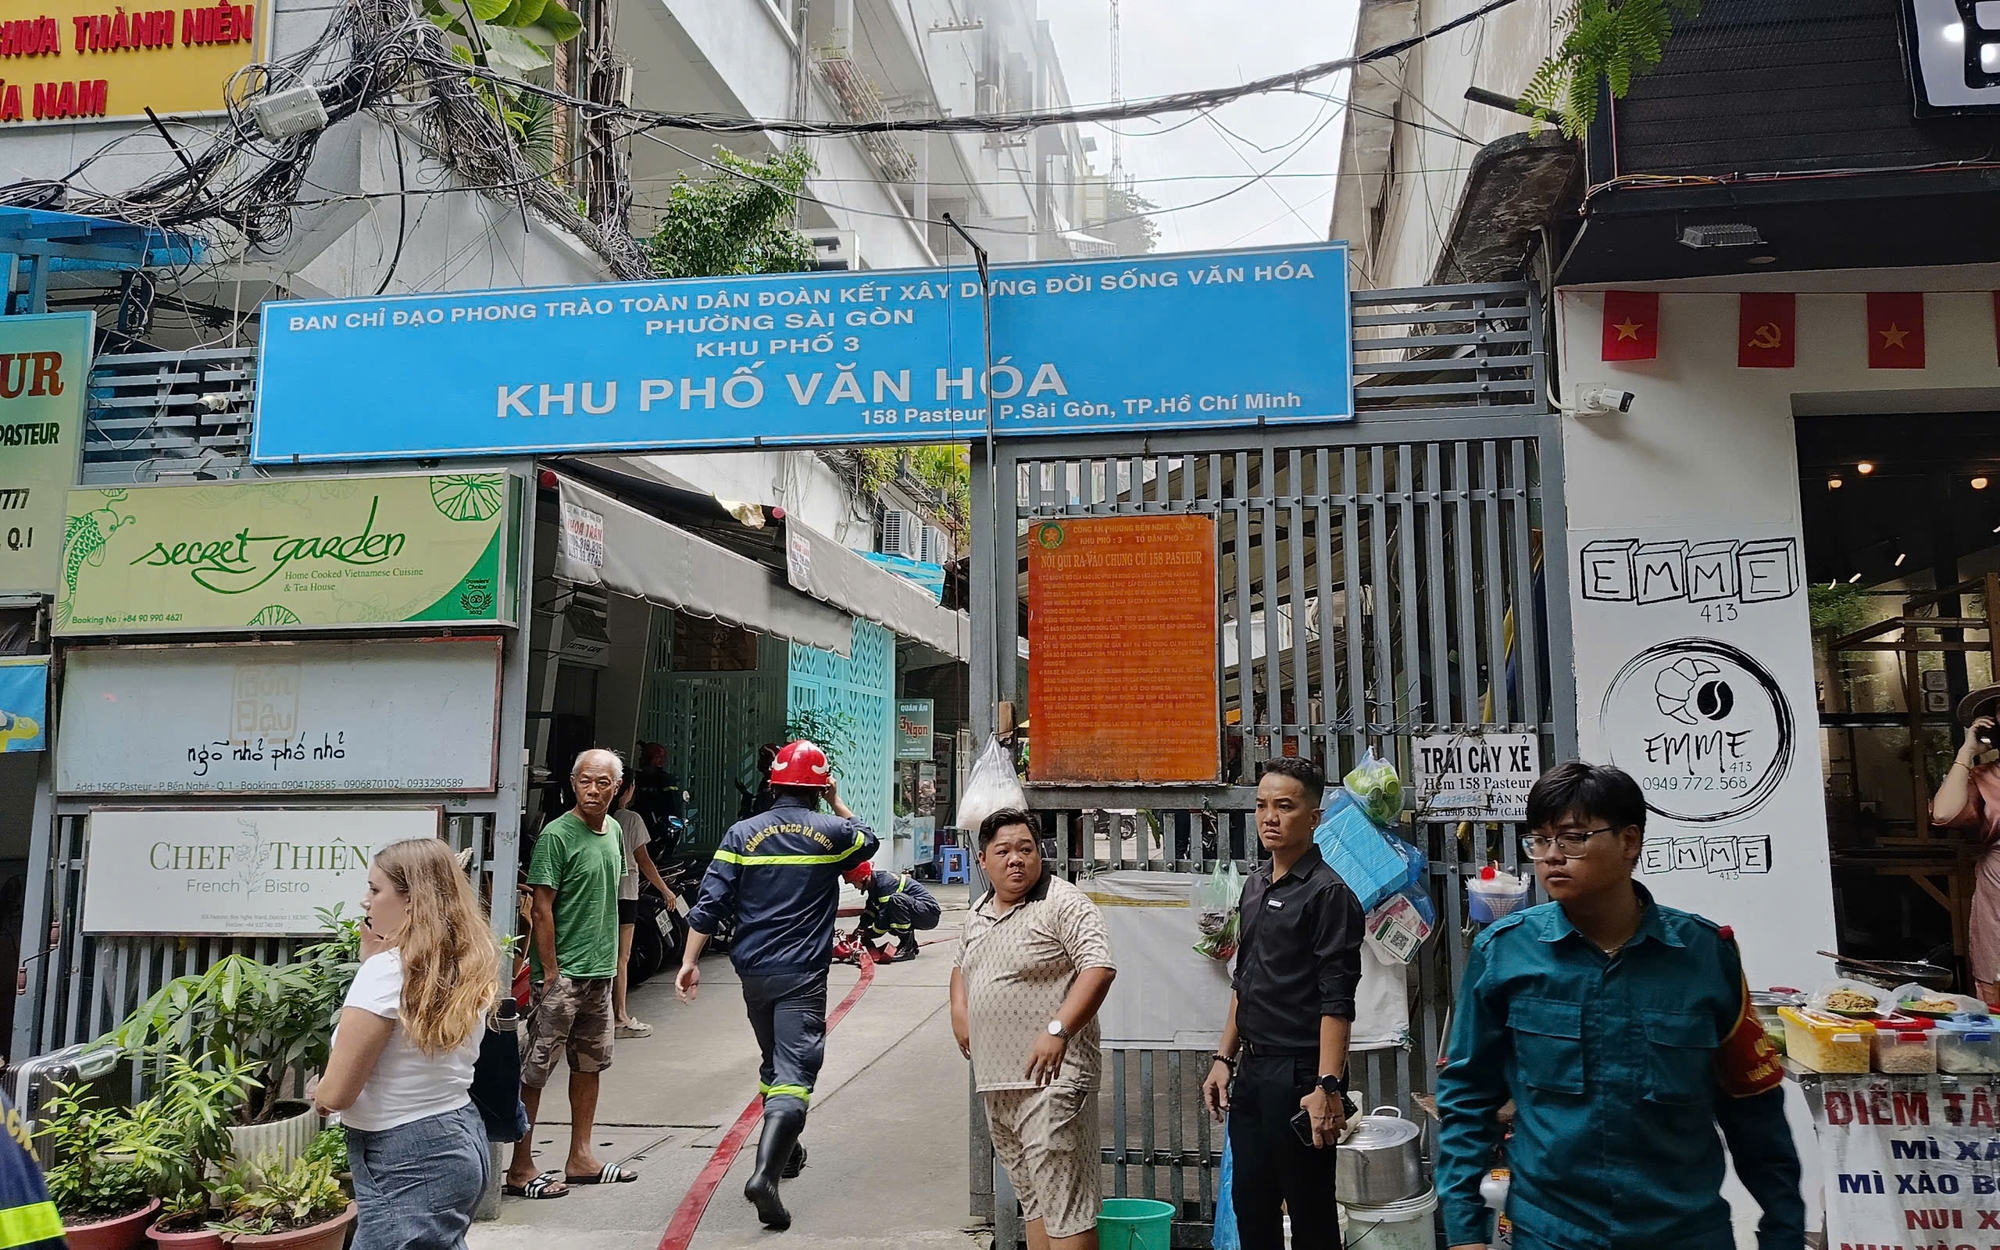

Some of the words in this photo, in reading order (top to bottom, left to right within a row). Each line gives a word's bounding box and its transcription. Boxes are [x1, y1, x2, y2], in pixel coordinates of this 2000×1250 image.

[0, 15, 61, 57] HƯA
[73, 6, 176, 54] THÀNH
[181, 0, 255, 47] NIÊN
[33, 79, 108, 121] NAM
[289, 315, 338, 331] BAN
[344, 307, 385, 328] CHỈ
[392, 309, 444, 327] ĐẠO
[451, 303, 537, 323] PHONG
[544, 297, 614, 317] TRÀO
[620, 293, 688, 313] TOÀN
[696, 289, 751, 310] DÂN
[758, 286, 831, 307] ĐOÀN
[840, 280, 892, 303] KẾT
[900, 280, 952, 301] XÂY
[1045, 270, 1092, 294] ĐỜI
[1100, 268, 1178, 291] SỐNG
[1187, 265, 1245, 286] VĂN
[1254, 259, 1316, 281] HÓA
[645, 312, 775, 335] PHƯỜNG
[784, 308, 835, 329] SÀI
[845, 307, 914, 328] GÒN
[696, 341, 759, 358] KHU
[769, 330, 834, 356] PHỐ
[843, 336, 860, 352] 3
[496, 380, 617, 418] KHU
[639, 360, 766, 412] PHỐ
[785, 361, 912, 406] VĂN
[935, 355, 1069, 401] HÓA
[861, 408, 897, 425] 158
[904, 407, 987, 424] Pasteur
[1000, 402, 1056, 421] P.Sài
[1067, 399, 1116, 419] Gòn,
[1123, 393, 1191, 416] TP.Hồ
[1199, 393, 1238, 412] Chí
[1245, 392, 1302, 410] Minh
[1080, 537, 1095, 545] KHU
[285, 571, 309, 580] Home
[311, 570, 342, 579] Cooked
[344, 569, 390, 578] Vietnamese
[392, 567, 424, 577] Cuisine
[1041, 552, 1055, 570] NỘI
[1057, 554, 1072, 571] QUI
[1105, 553, 1133, 567] CHUNG
[1149, 553, 1162, 566] 158
[1165, 550, 1203, 565] PASTEUR
[284, 584, 291, 592] &
[293, 583, 308, 592] Tea
[310, 582, 336, 591] House
[1588, 553, 1787, 599] EMME
[72, 616, 103, 625] Booking
[138, 614, 148, 622] 90
[150, 613, 164, 622] 990
[165, 613, 183, 622] 4621
[1700, 603, 1738, 623] 413
[899, 715, 906, 729] 3
[905, 721, 929, 738] Ngon
[187, 738, 230, 776] ngõ
[233, 737, 264, 762] nhỏ
[271, 731, 306, 771] phố
[313, 731, 345, 761] nhỏ
[1420, 738, 1463, 774] TRÁI
[1468, 739, 1502, 774] CÂY
[1508, 735, 1532, 772] XẺ
[1644, 730, 1754, 776] EMME
[75, 783, 95, 791] Add:
[97, 782, 118, 791] 156C
[120, 782, 152, 791] Pasteur
[281, 780, 336, 789] 0904128585
[344, 779, 399, 788] 0906870102
[407, 778, 464, 788] 0933290589
[1459, 777, 1480, 790] 158
[1483, 777, 1532, 790] Pasteur
[1642, 776, 1748, 791] 0949.772.568
[763, 824, 779, 837] SÁT
[780, 823, 802, 834] PCCC
[802, 825, 814, 837] VÀ
[813, 831, 835, 851] CNCH
[149, 841, 235, 871] CHEF
[1644, 842, 1766, 871] EMME
[187, 878, 240, 893] French
[264, 878, 310, 893] Bistro
[1719, 872, 1740, 881] 413
[1942, 1086, 2000, 1127] TÂ
[1890, 1136, 1940, 1159] MÌ
[1838, 1170, 1885, 1194] MÌ
[1894, 1169, 1960, 1194] XÀO
[1972, 1174, 2000, 1195] B
[1904, 1208, 1963, 1230] NUI
